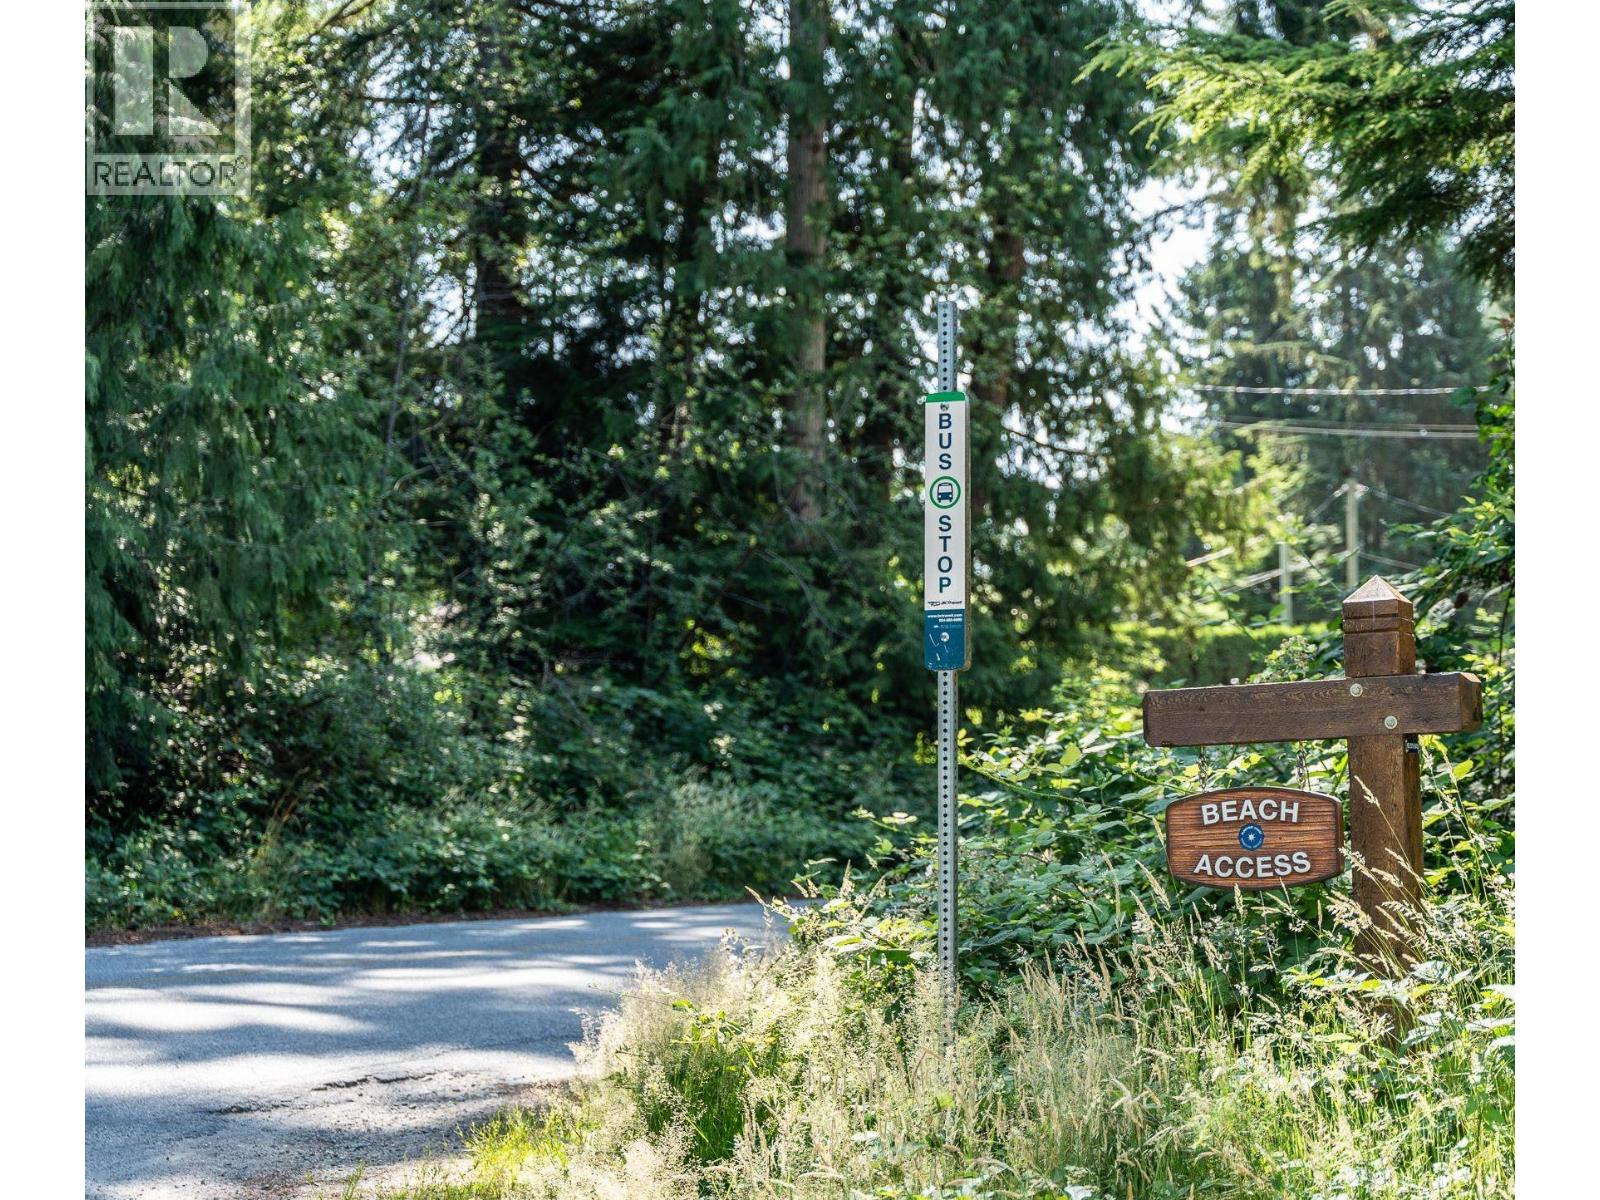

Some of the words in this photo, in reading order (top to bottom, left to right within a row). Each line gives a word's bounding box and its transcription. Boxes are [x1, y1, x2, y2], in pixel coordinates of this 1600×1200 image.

[938, 412, 952, 470] BUS
[937, 514, 953, 594] STOP
[1201, 799, 1299, 825] BEACH
[1193, 851, 1311, 879] ACCESS
